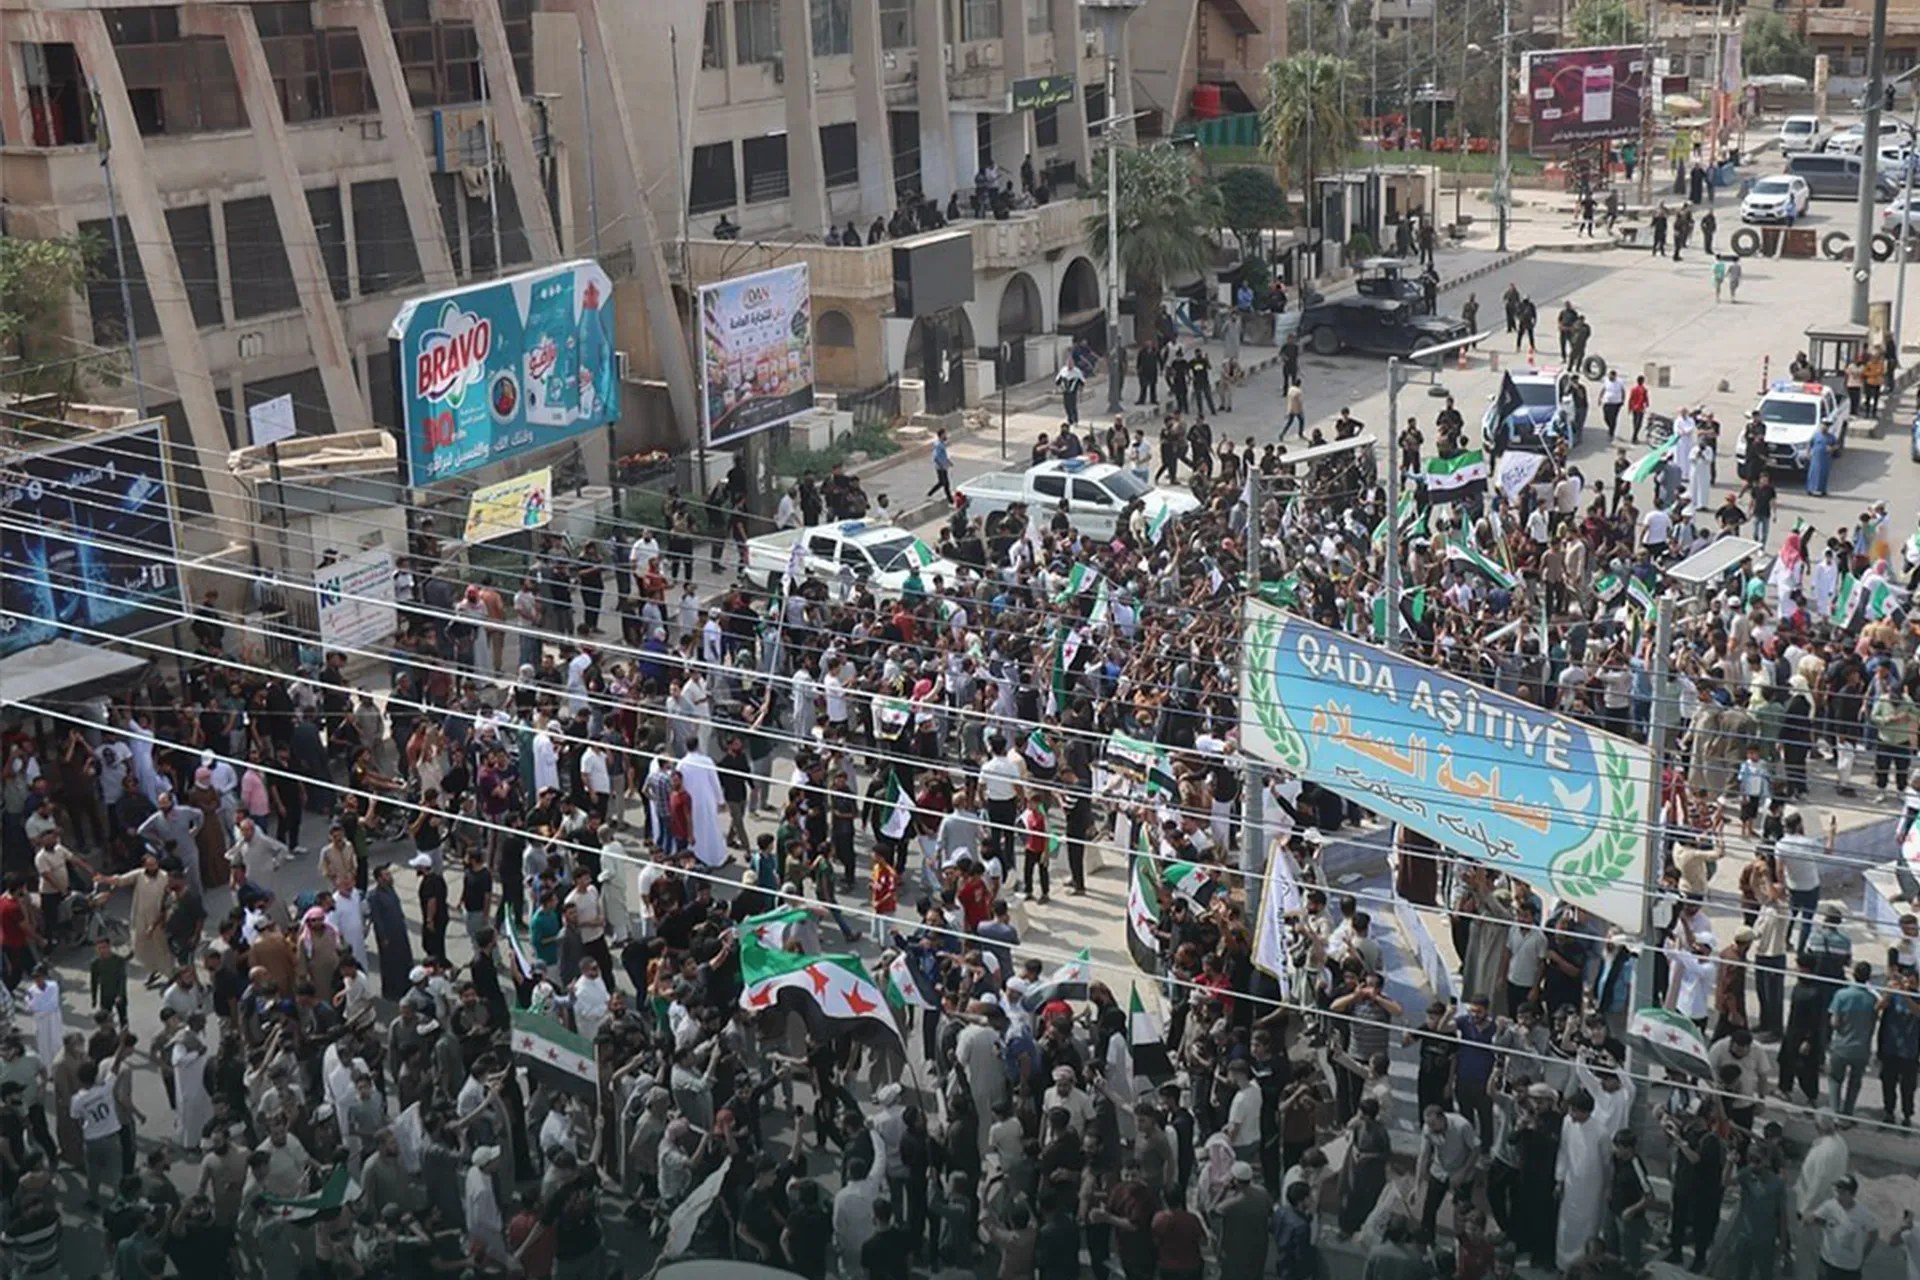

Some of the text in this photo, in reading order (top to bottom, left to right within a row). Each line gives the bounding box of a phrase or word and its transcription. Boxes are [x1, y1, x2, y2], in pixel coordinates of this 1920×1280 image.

[418, 320, 490, 396] BRAVO
[1295, 633, 1574, 771] QADA AŞÎTIYÊ
[1310, 698, 1552, 836] ساحة السلام
[88, 1103, 110, 1123] 10
